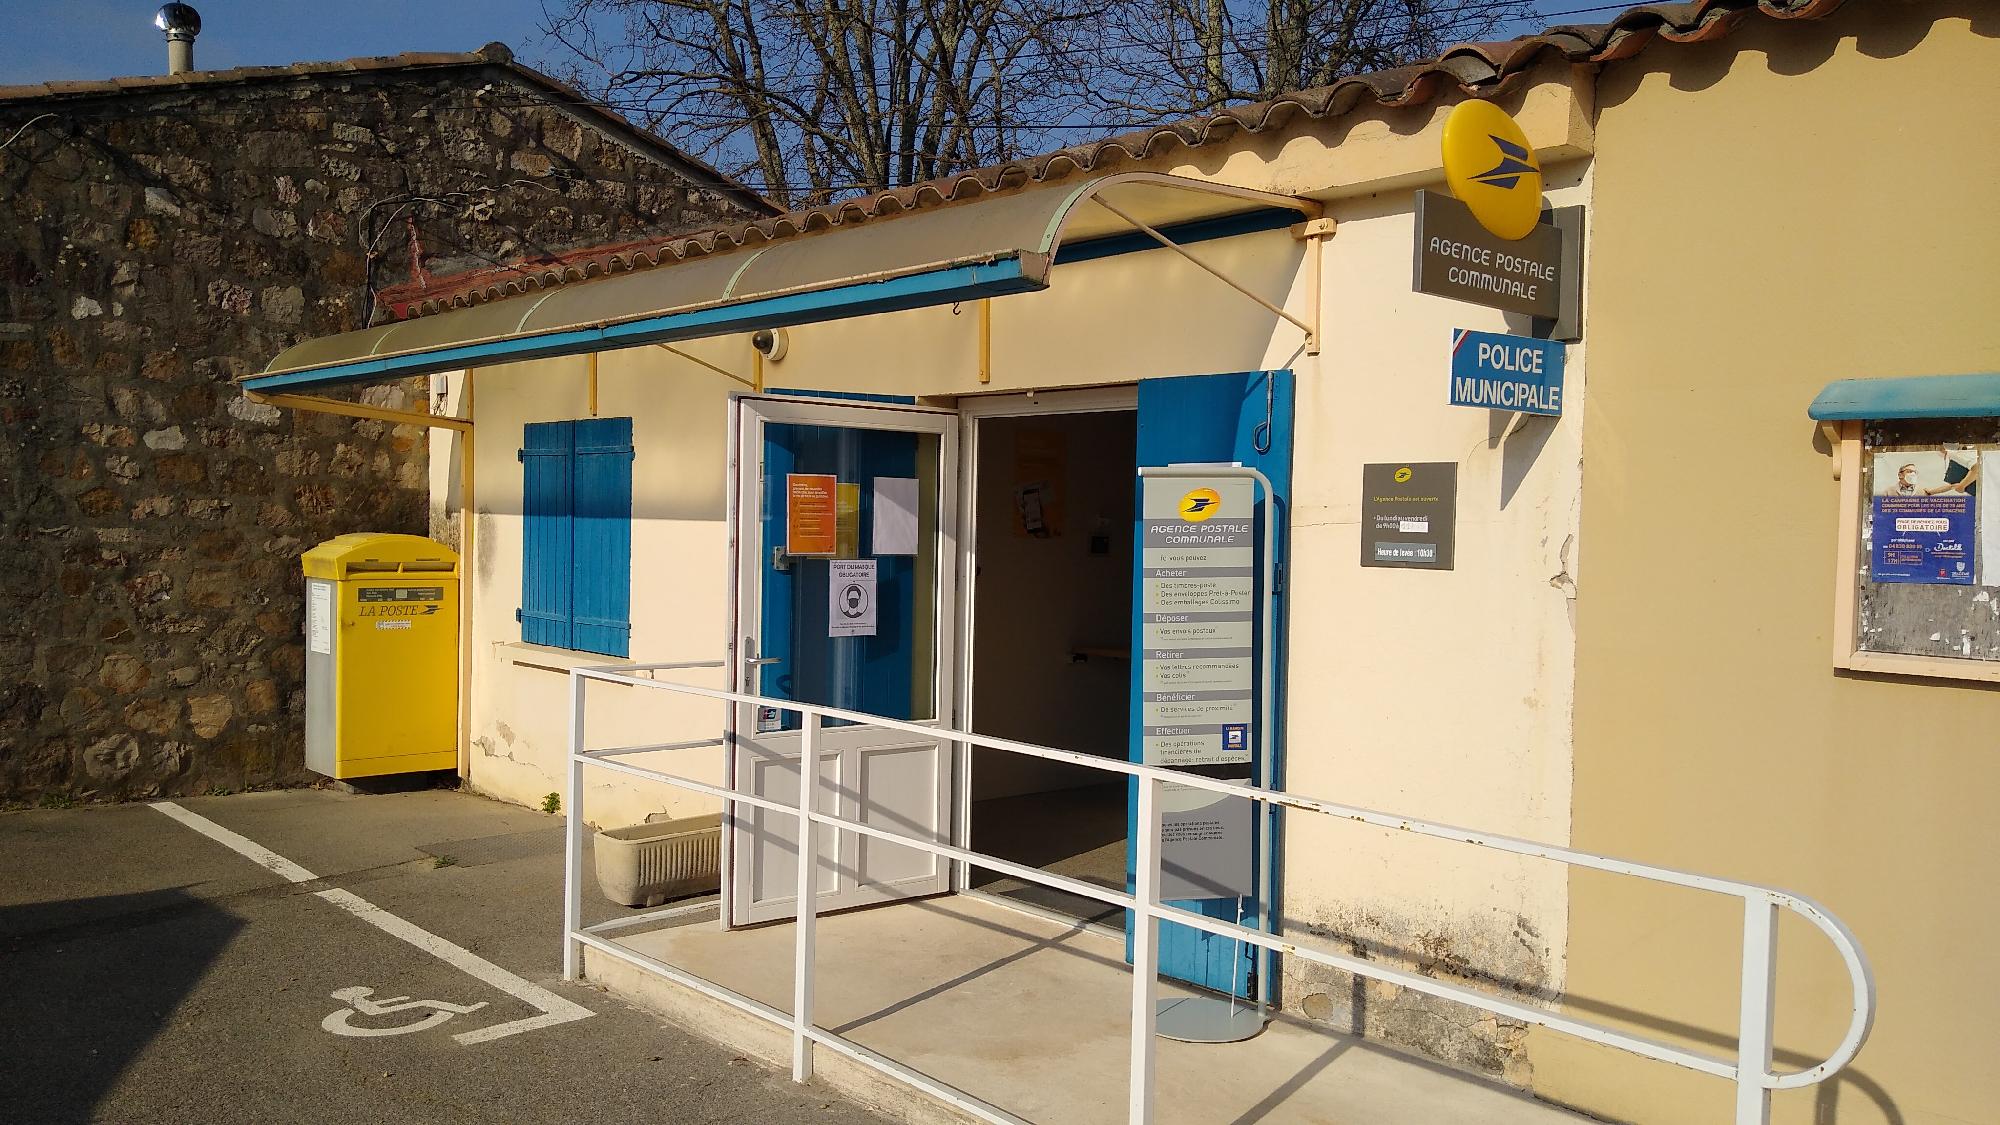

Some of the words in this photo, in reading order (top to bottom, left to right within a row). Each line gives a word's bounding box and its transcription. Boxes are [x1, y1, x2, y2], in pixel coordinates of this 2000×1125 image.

[1430, 236, 1491, 266] AGENCE
[1496, 252, 1556, 282] POSTALE
[1448, 266, 1538, 301] COMMUNALE
[1478, 342, 1544, 374] POLICE
[1455, 376, 1560, 410] MUNICIPALE
[1150, 525, 1197, 533] AGENCE
[1201, 524, 1249, 533] POSTALE
[359, 606, 376, 616] LA
[378, 605, 418, 616] POSTE
[1156, 614, 1188, 623] Déposer
[1156, 650, 1184, 658] Retirer
[1156, 693, 1195, 702] Bénéficier
